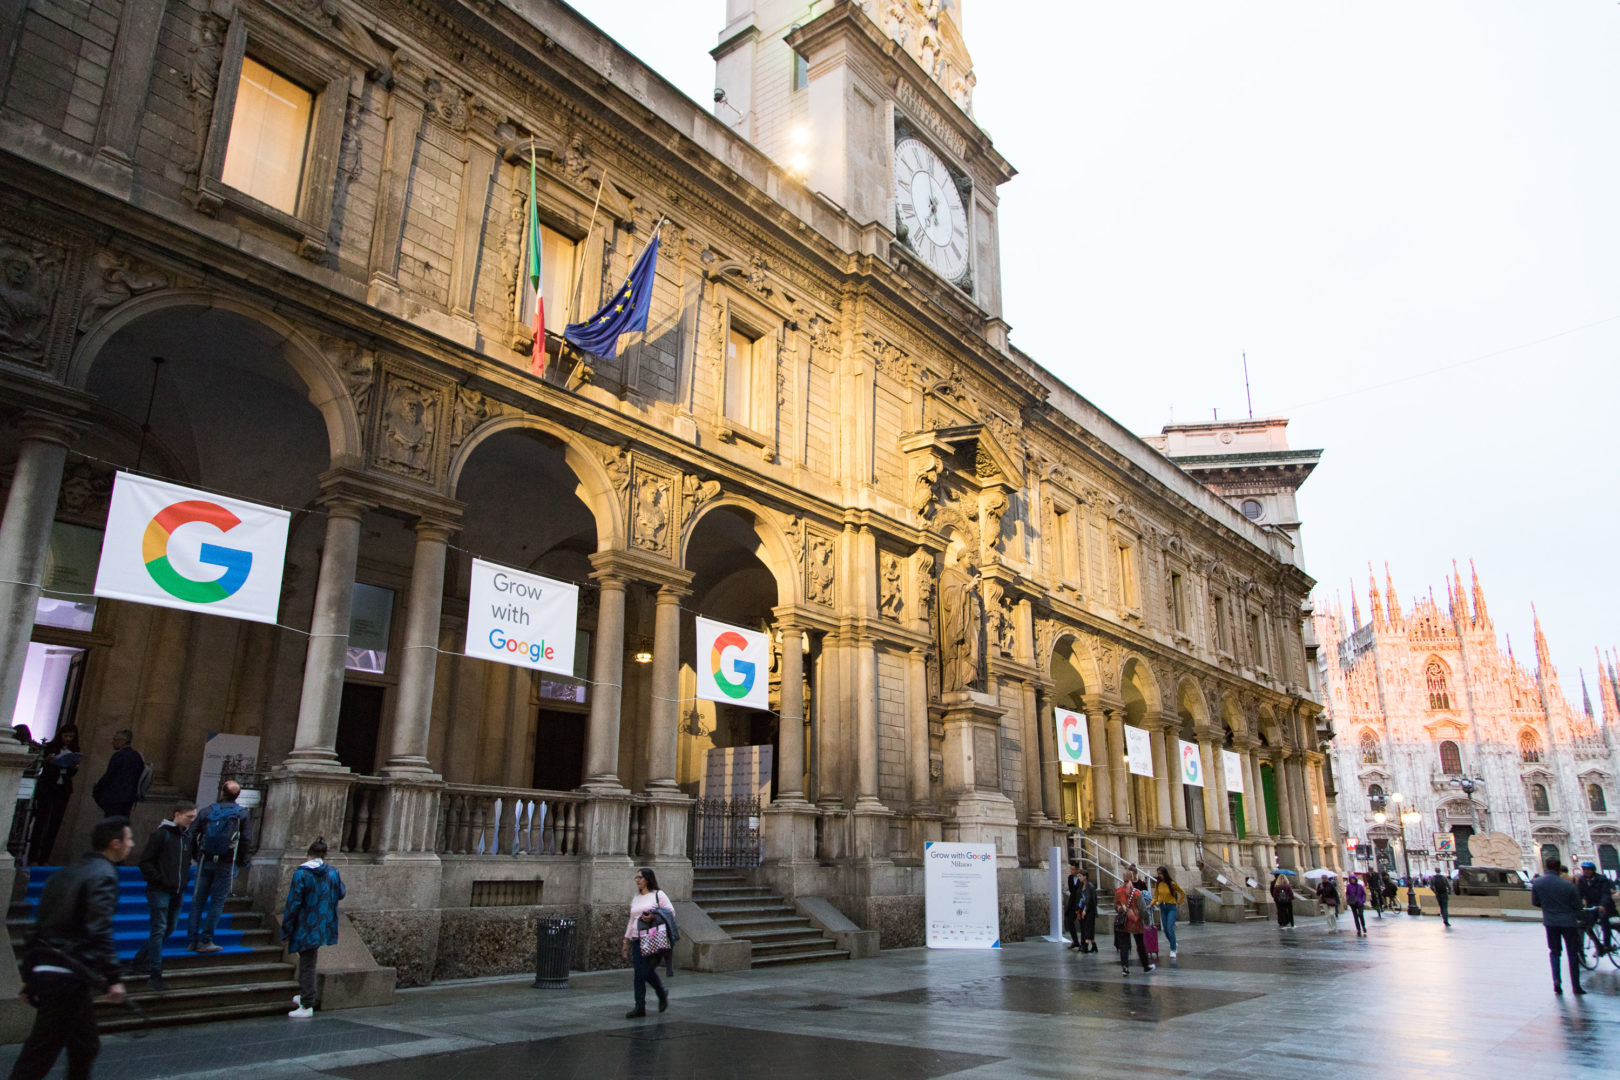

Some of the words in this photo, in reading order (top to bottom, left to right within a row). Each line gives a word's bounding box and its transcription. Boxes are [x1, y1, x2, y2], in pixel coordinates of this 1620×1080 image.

[142, 500, 253, 603] G
[493, 572, 543, 601] Grow
[491, 602, 531, 626] with
[488, 627, 555, 664] Google
[711, 632, 756, 699] G
[1063, 715, 1082, 760] G
[1183, 745, 1198, 782] G
[930, 851, 950, 859] Grow
[950, 851, 966, 859] with
[966, 851, 991, 862] Google
